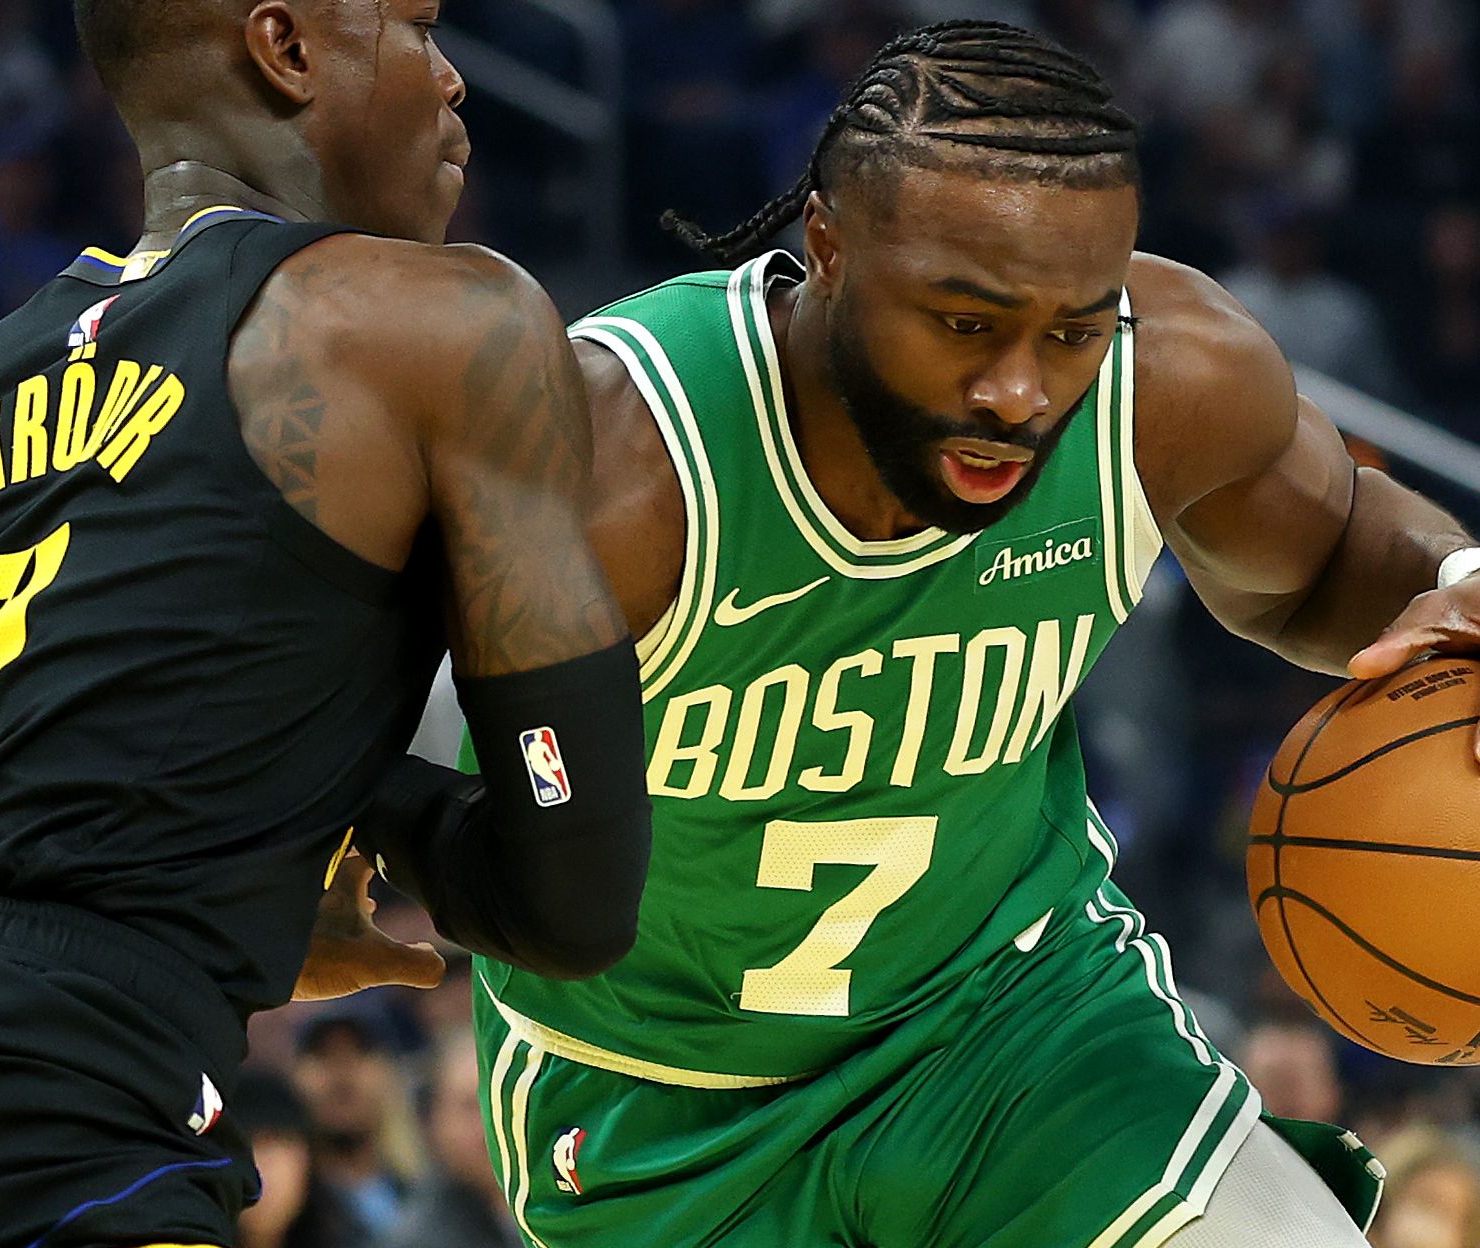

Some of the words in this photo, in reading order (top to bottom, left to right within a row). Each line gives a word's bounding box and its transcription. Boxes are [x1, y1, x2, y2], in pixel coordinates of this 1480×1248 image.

[978, 536, 1093, 586] Amica
[645, 613, 1095, 801] BOSTON
[738, 815, 938, 1018] 7
